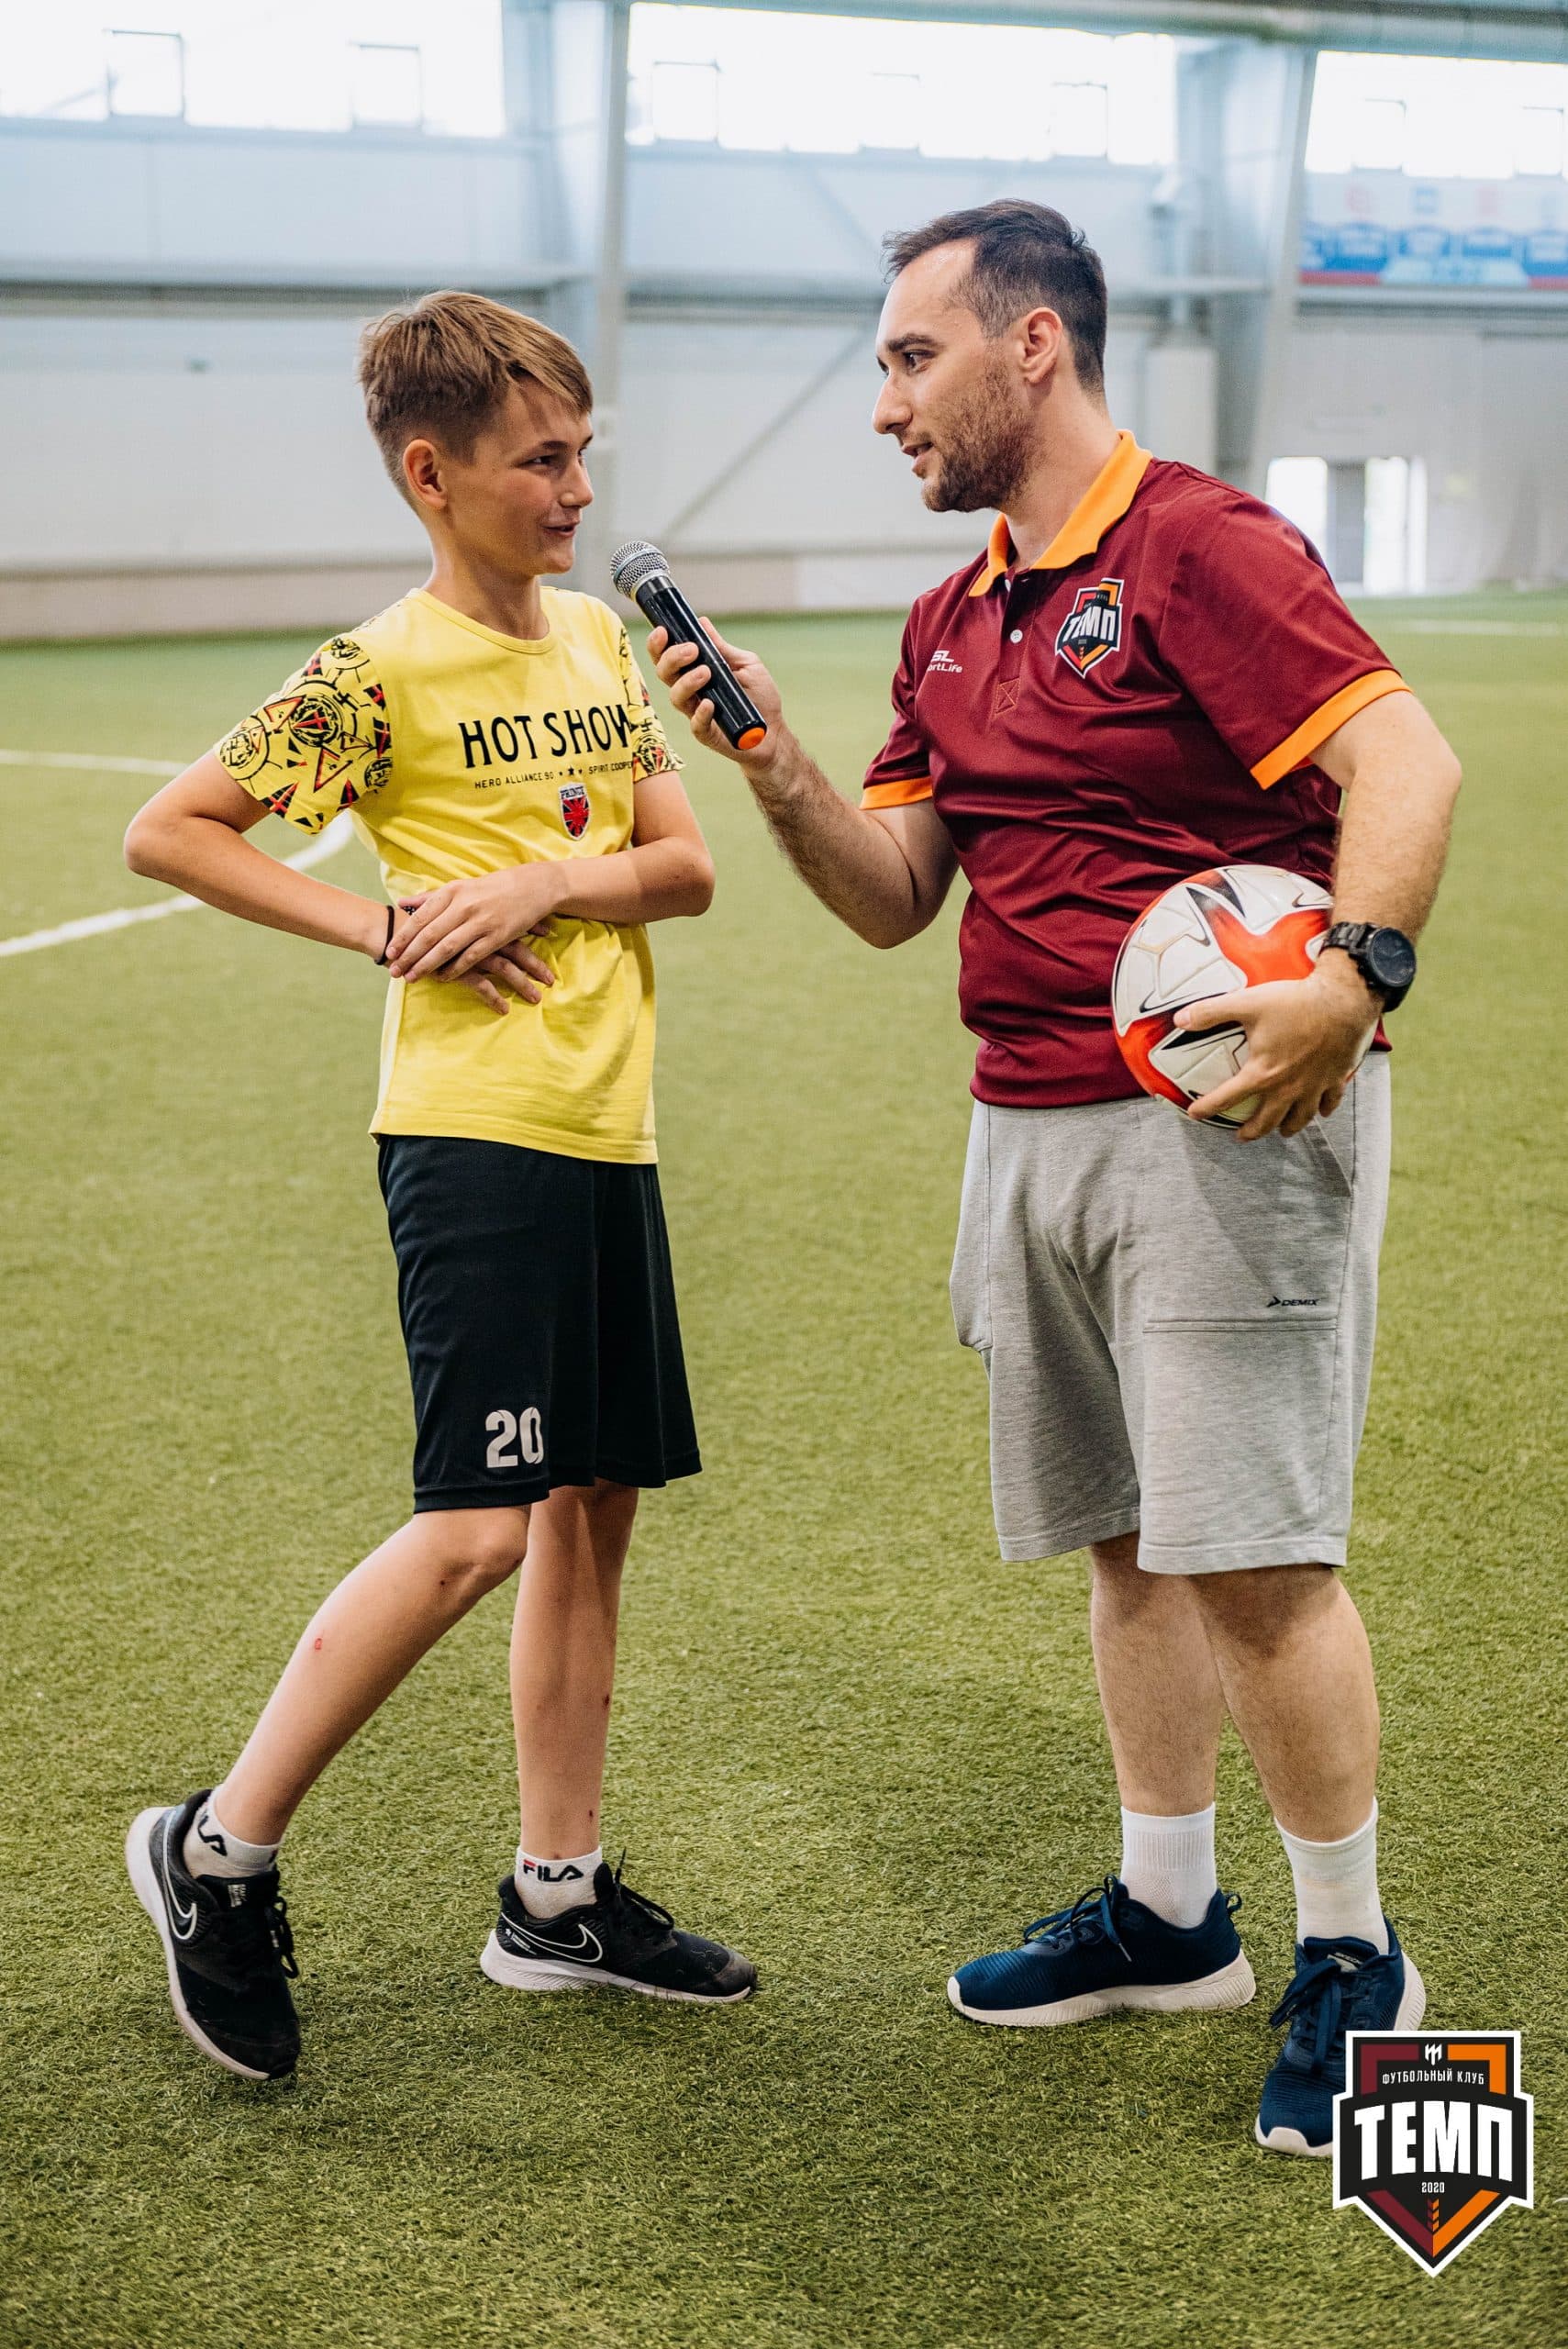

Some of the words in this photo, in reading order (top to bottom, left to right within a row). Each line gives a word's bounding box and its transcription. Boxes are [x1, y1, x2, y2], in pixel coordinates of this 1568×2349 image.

[458, 716, 538, 769] HOT
[543, 704, 632, 757] SHOW
[474, 777, 502, 789] HERO
[506, 773, 543, 785] ALLIANCE
[1282, 1298, 1319, 1307] DEMIX
[485, 1407, 544, 1468] 20
[523, 1859, 584, 1882] FILA
